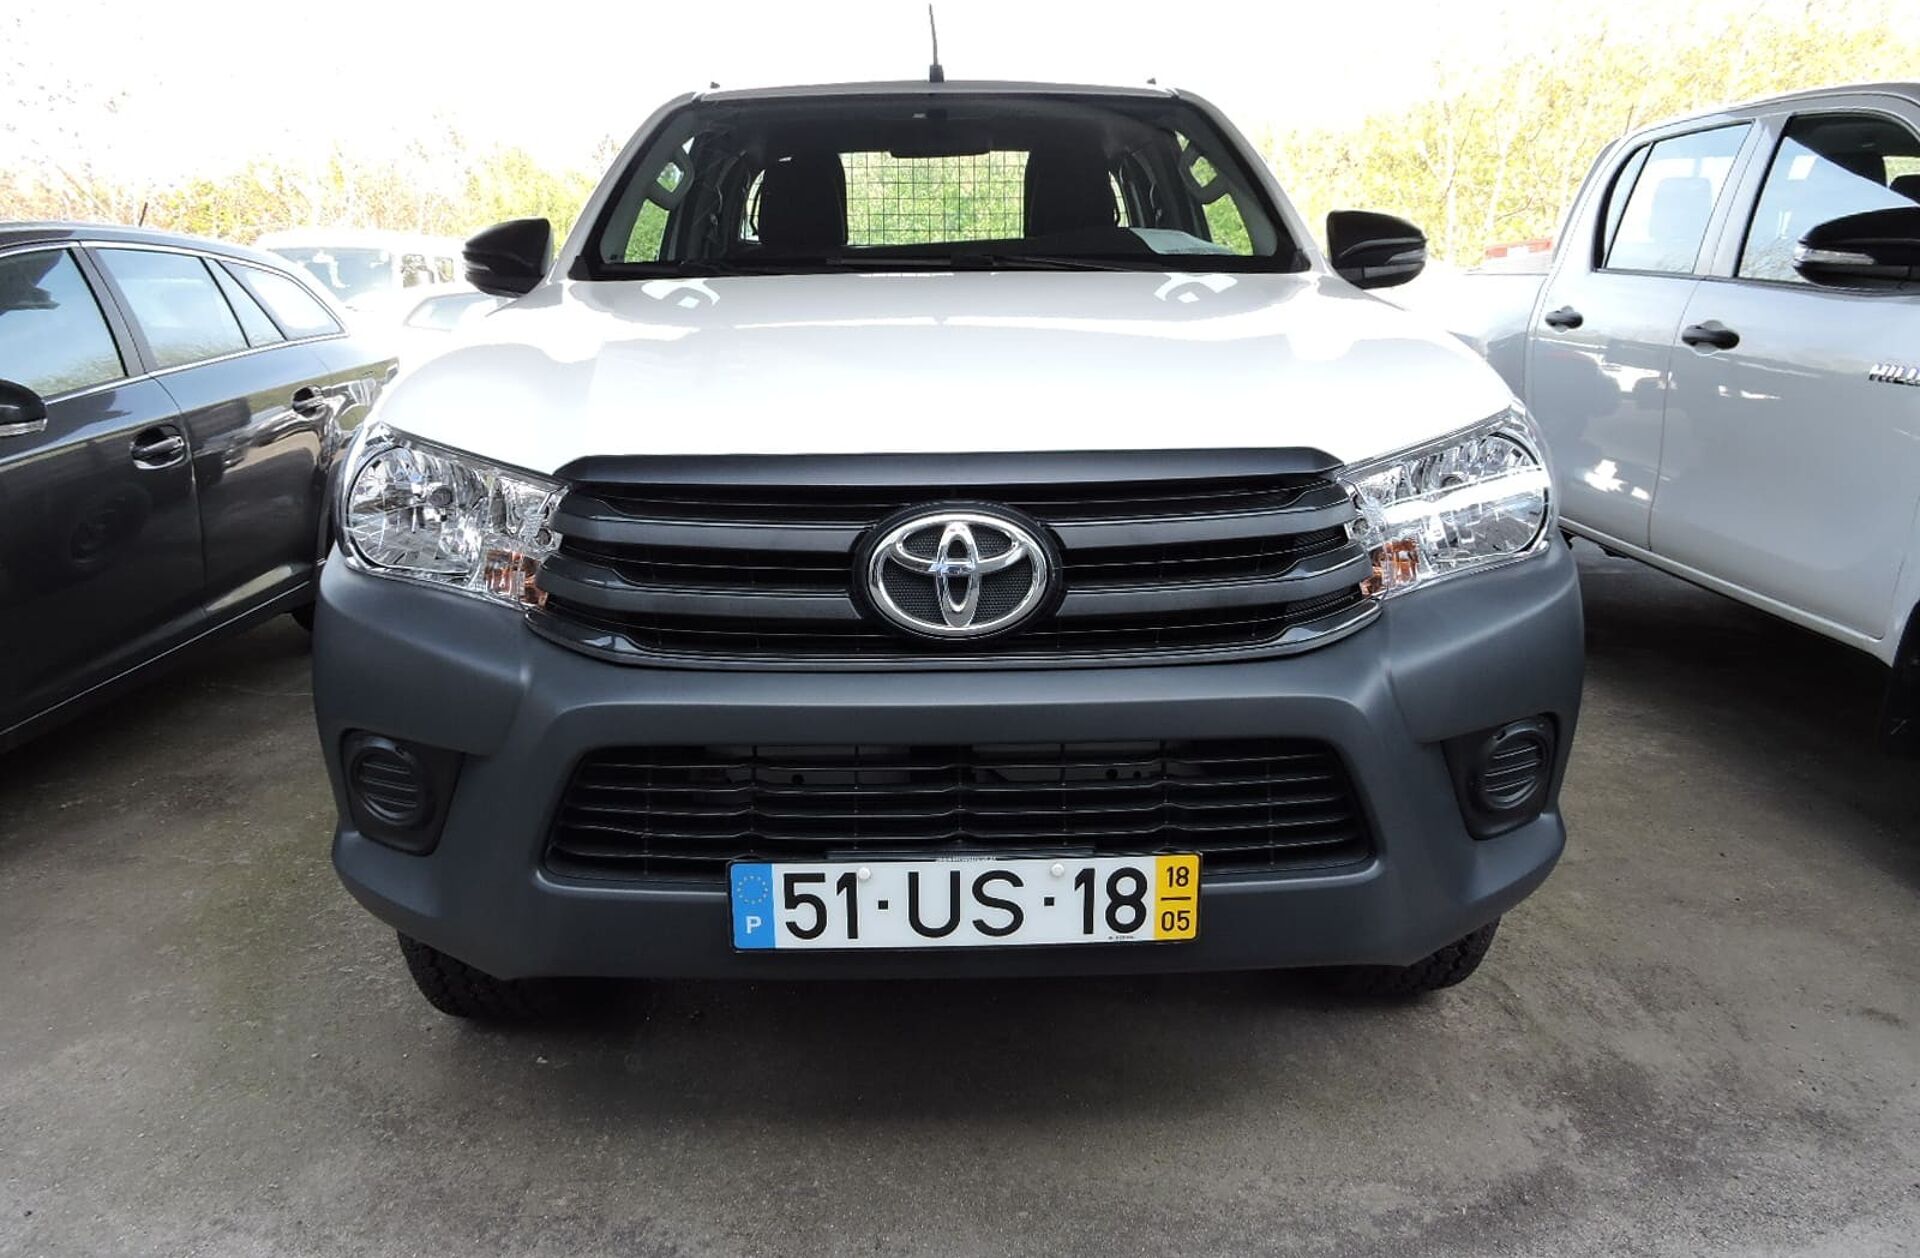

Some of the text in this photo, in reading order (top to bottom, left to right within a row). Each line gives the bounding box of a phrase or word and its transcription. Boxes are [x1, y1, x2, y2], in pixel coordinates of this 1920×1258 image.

[1166, 866, 1190, 888] 18
[745, 915, 762, 934] P
[1161, 910, 1190, 932] 05
